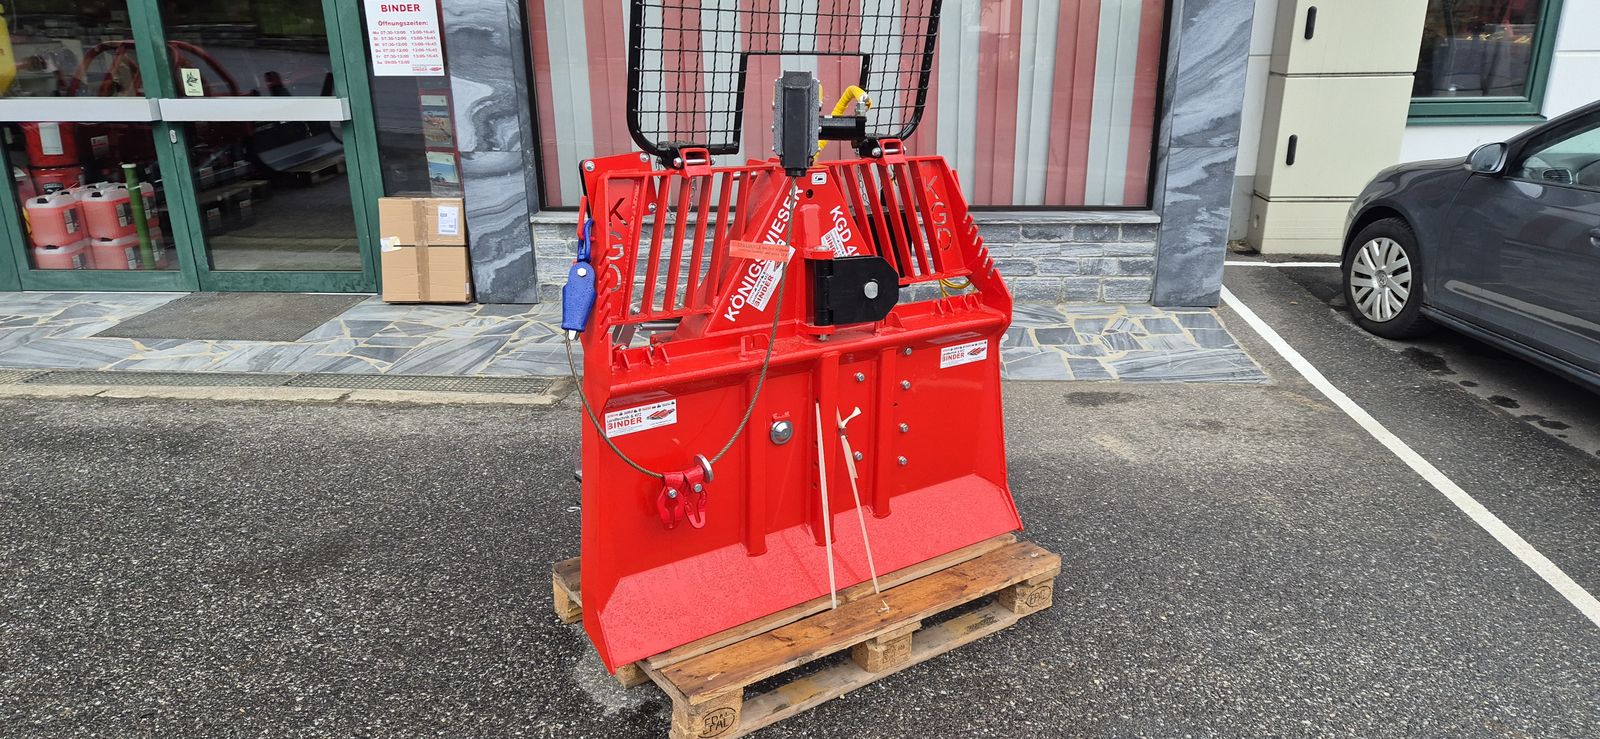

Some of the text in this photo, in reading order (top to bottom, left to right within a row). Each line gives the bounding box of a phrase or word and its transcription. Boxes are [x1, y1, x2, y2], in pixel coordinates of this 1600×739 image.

[381, 4, 421, 12] BINDER
[829, 205, 852, 243] KGD
[754, 275, 774, 307] BINDER
[607, 416, 643, 430] BINDER
